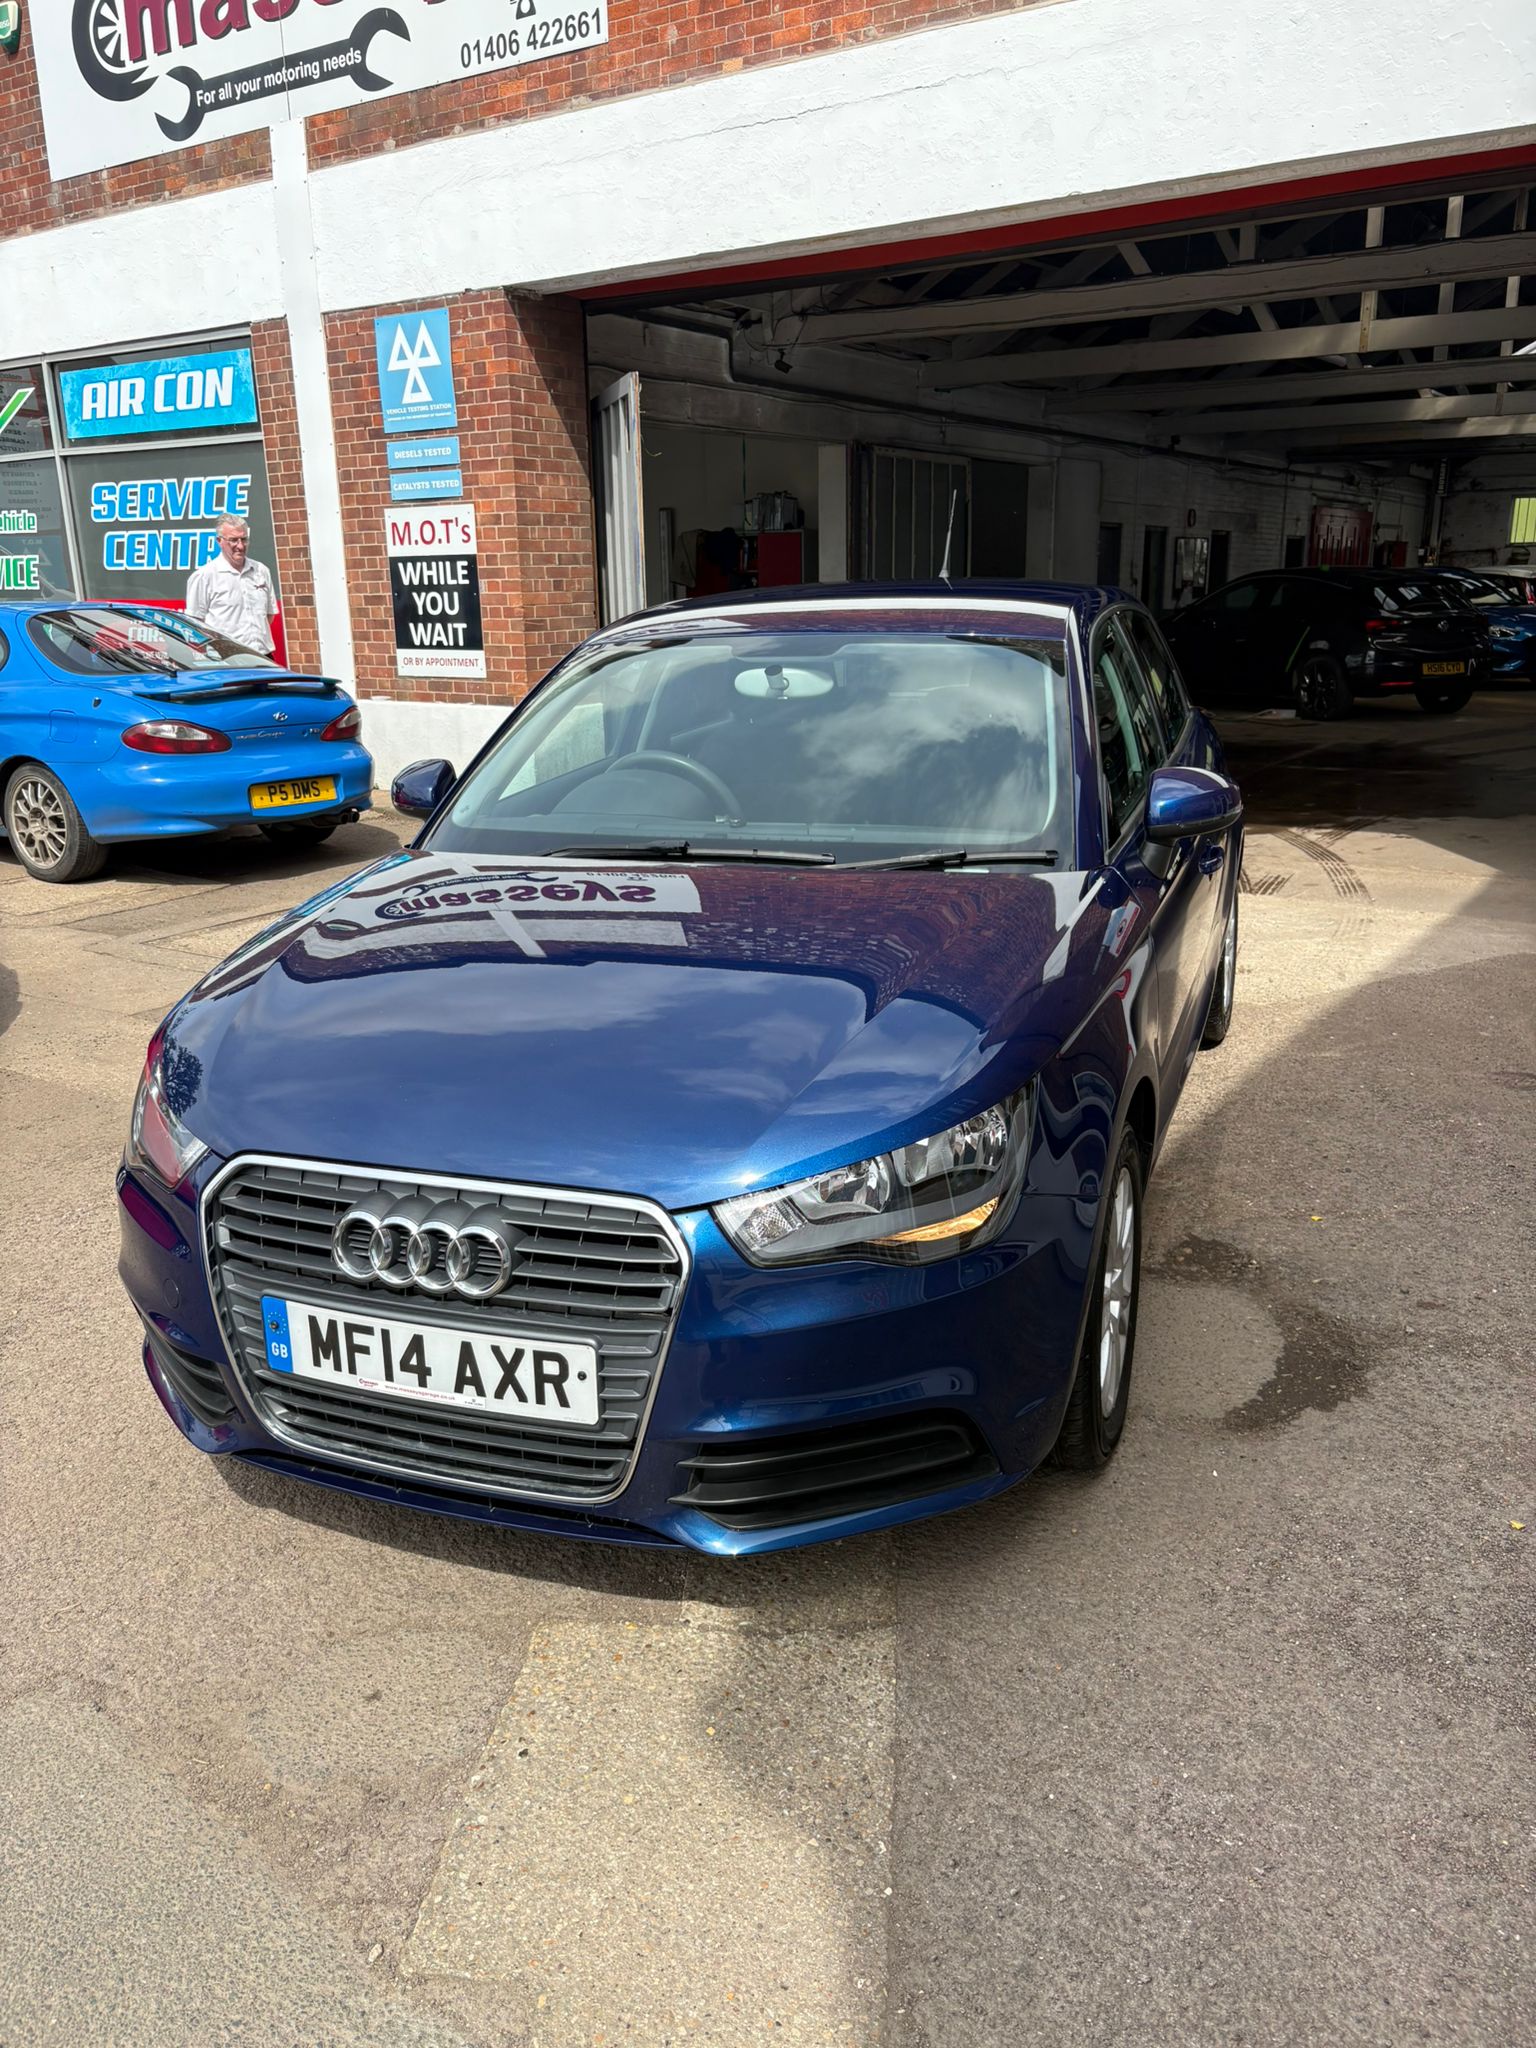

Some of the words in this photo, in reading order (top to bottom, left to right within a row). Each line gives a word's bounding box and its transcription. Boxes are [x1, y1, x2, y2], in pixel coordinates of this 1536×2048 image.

[460, 29, 521, 69] 01406
[526, 7, 602, 51] 422661
[196, 89, 216, 107] For
[218, 81, 233, 101] all
[234, 76, 262, 101] your
[264, 60, 320, 89] motoring
[323, 48, 362, 73] needs
[82, 377, 145, 420] AIR
[153, 366, 235, 413] CON
[394, 449, 423, 459] DIESELS
[424, 447, 451, 456] TESTED
[393, 480, 430, 491] CATALYSTS
[432, 479, 460, 488] TESTED
[91, 475, 251, 522] SERVICE
[391, 517, 471, 546] M.O.T's
[104, 528, 250, 570] CENTR
[398, 560, 470, 586] WHILE
[412, 591, 460, 616] YOU
[408, 622, 468, 647] WAIT
[403, 656, 415, 666] OR
[415, 656, 424, 666] BY
[425, 656, 480, 668] APPOINTMENT
[267, 784, 289, 803] P5
[291, 780, 321, 800] DMS
[271, 1341, 289, 1360] GB
[307, 1314, 432, 1388] MF14
[453, 1340, 571, 1409] AXR
